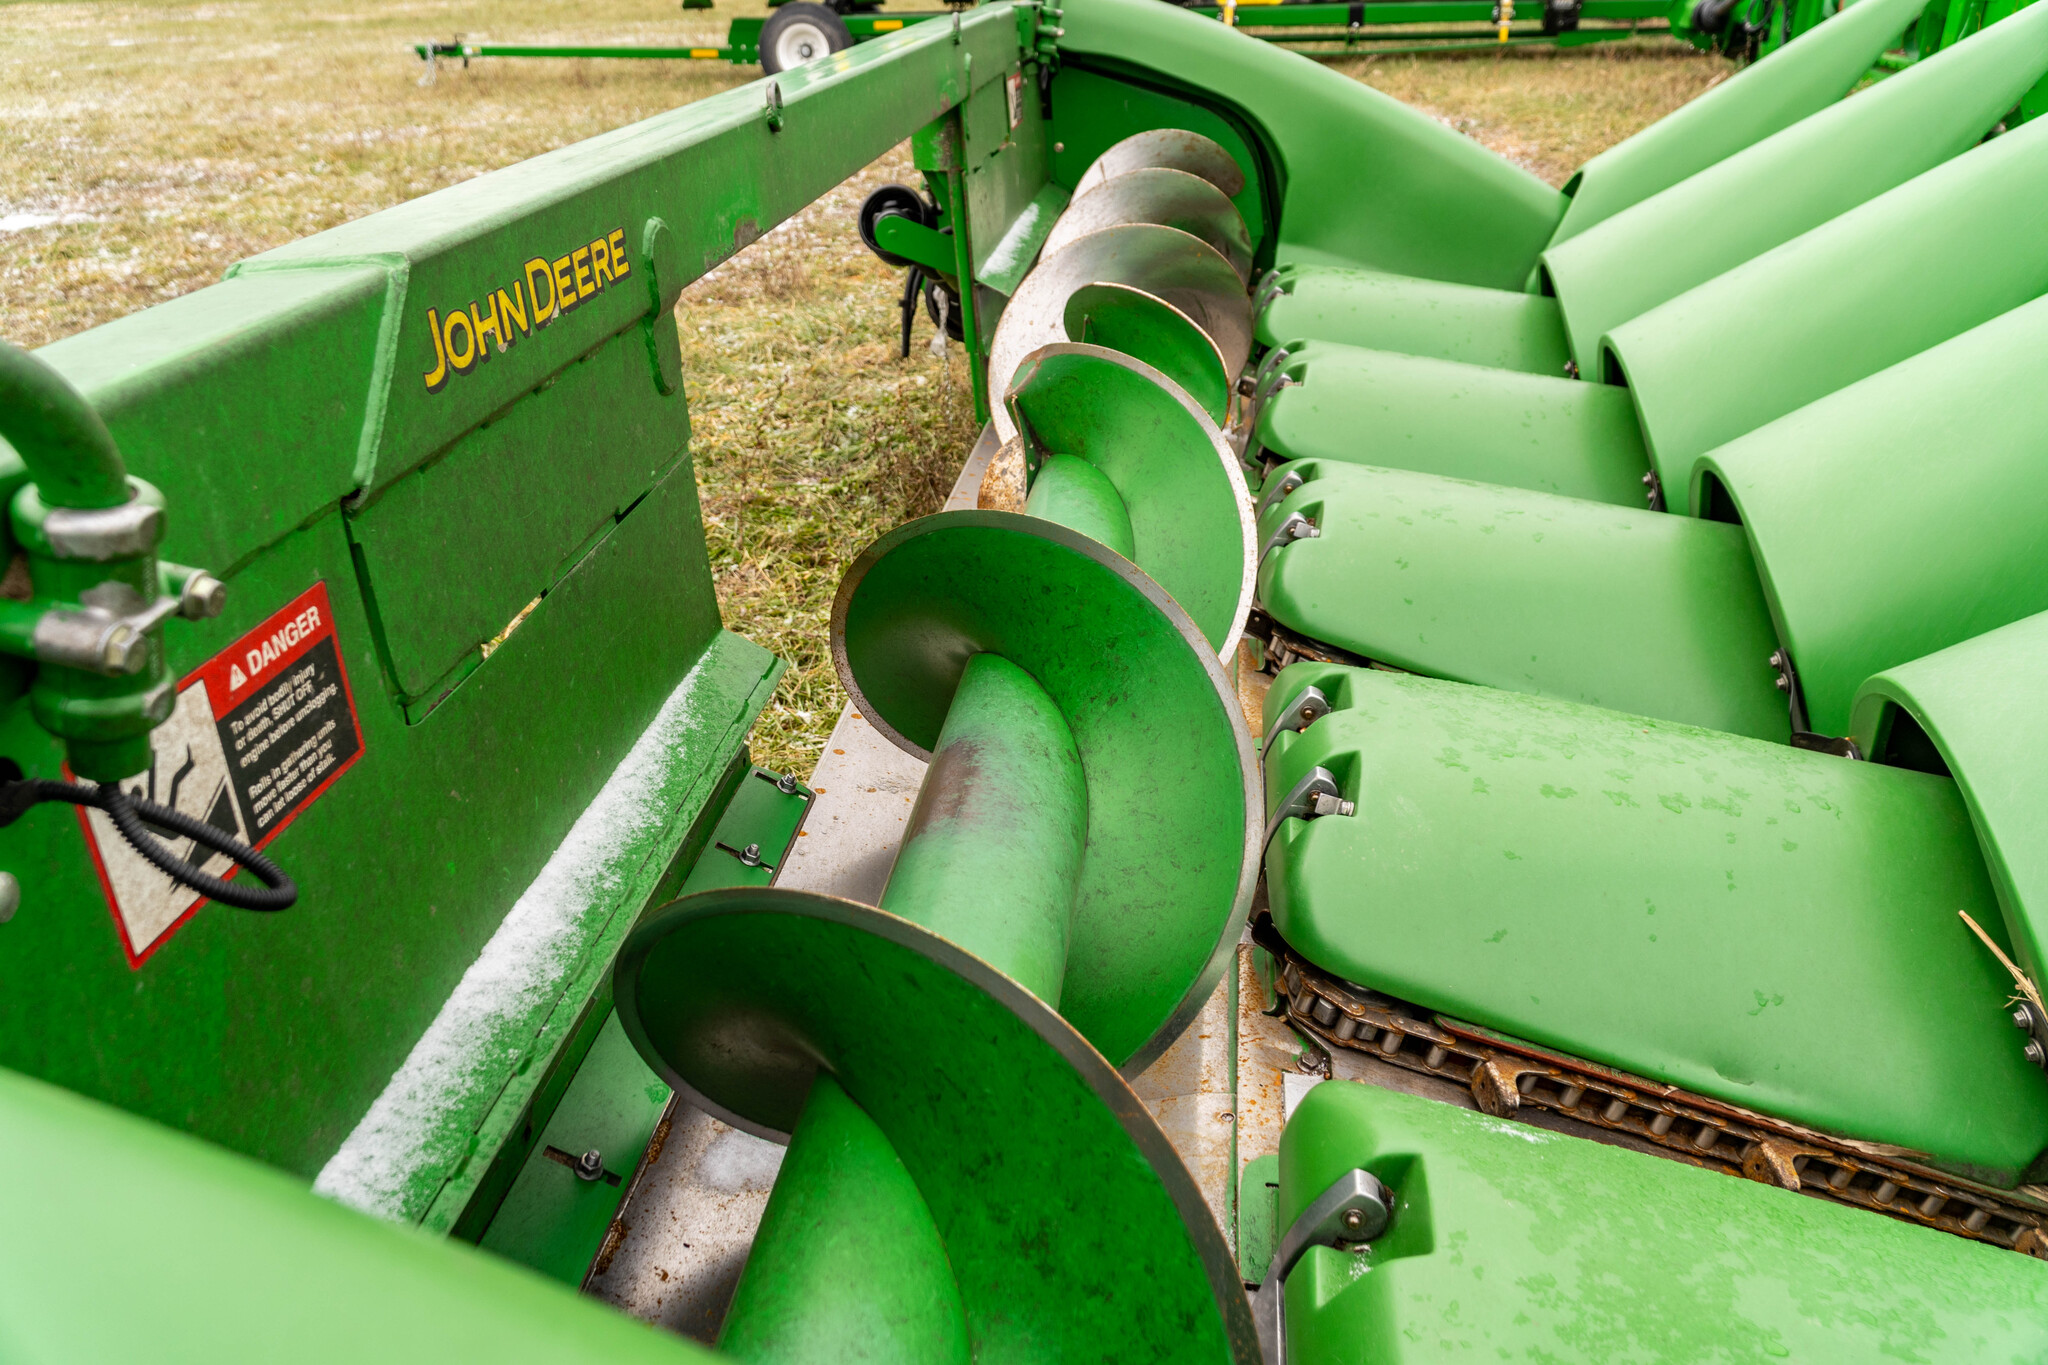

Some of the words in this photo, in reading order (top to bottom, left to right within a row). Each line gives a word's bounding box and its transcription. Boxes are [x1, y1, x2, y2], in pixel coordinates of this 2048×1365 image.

[423, 279, 533, 395] JOHN
[523, 227, 632, 331] DEERE
[246, 605, 321, 676] DANGER
[230, 720, 244, 735] To
[243, 698, 268, 726] avoid
[266, 679, 293, 707] bodily
[292, 663, 315, 687] injury
[234, 736, 246, 751] or
[271, 693, 296, 720] SHUT
[240, 738, 270, 768] engine
[268, 717, 296, 744] before
[295, 682, 338, 722] unclogging.
[248, 775, 272, 800] Rolls
[270, 767, 281, 780] in
[280, 735, 318, 775] gathering
[316, 720, 336, 740] units
[253, 788, 277, 815] move
[276, 767, 300, 792] faster
[299, 752, 318, 773] than
[316, 739, 333, 759] you
[257, 808, 275, 829] can
[272, 796, 287, 813] let
[283, 778, 307, 803] loose
[306, 767, 316, 783] of
[315, 753, 337, 775] stalk.
